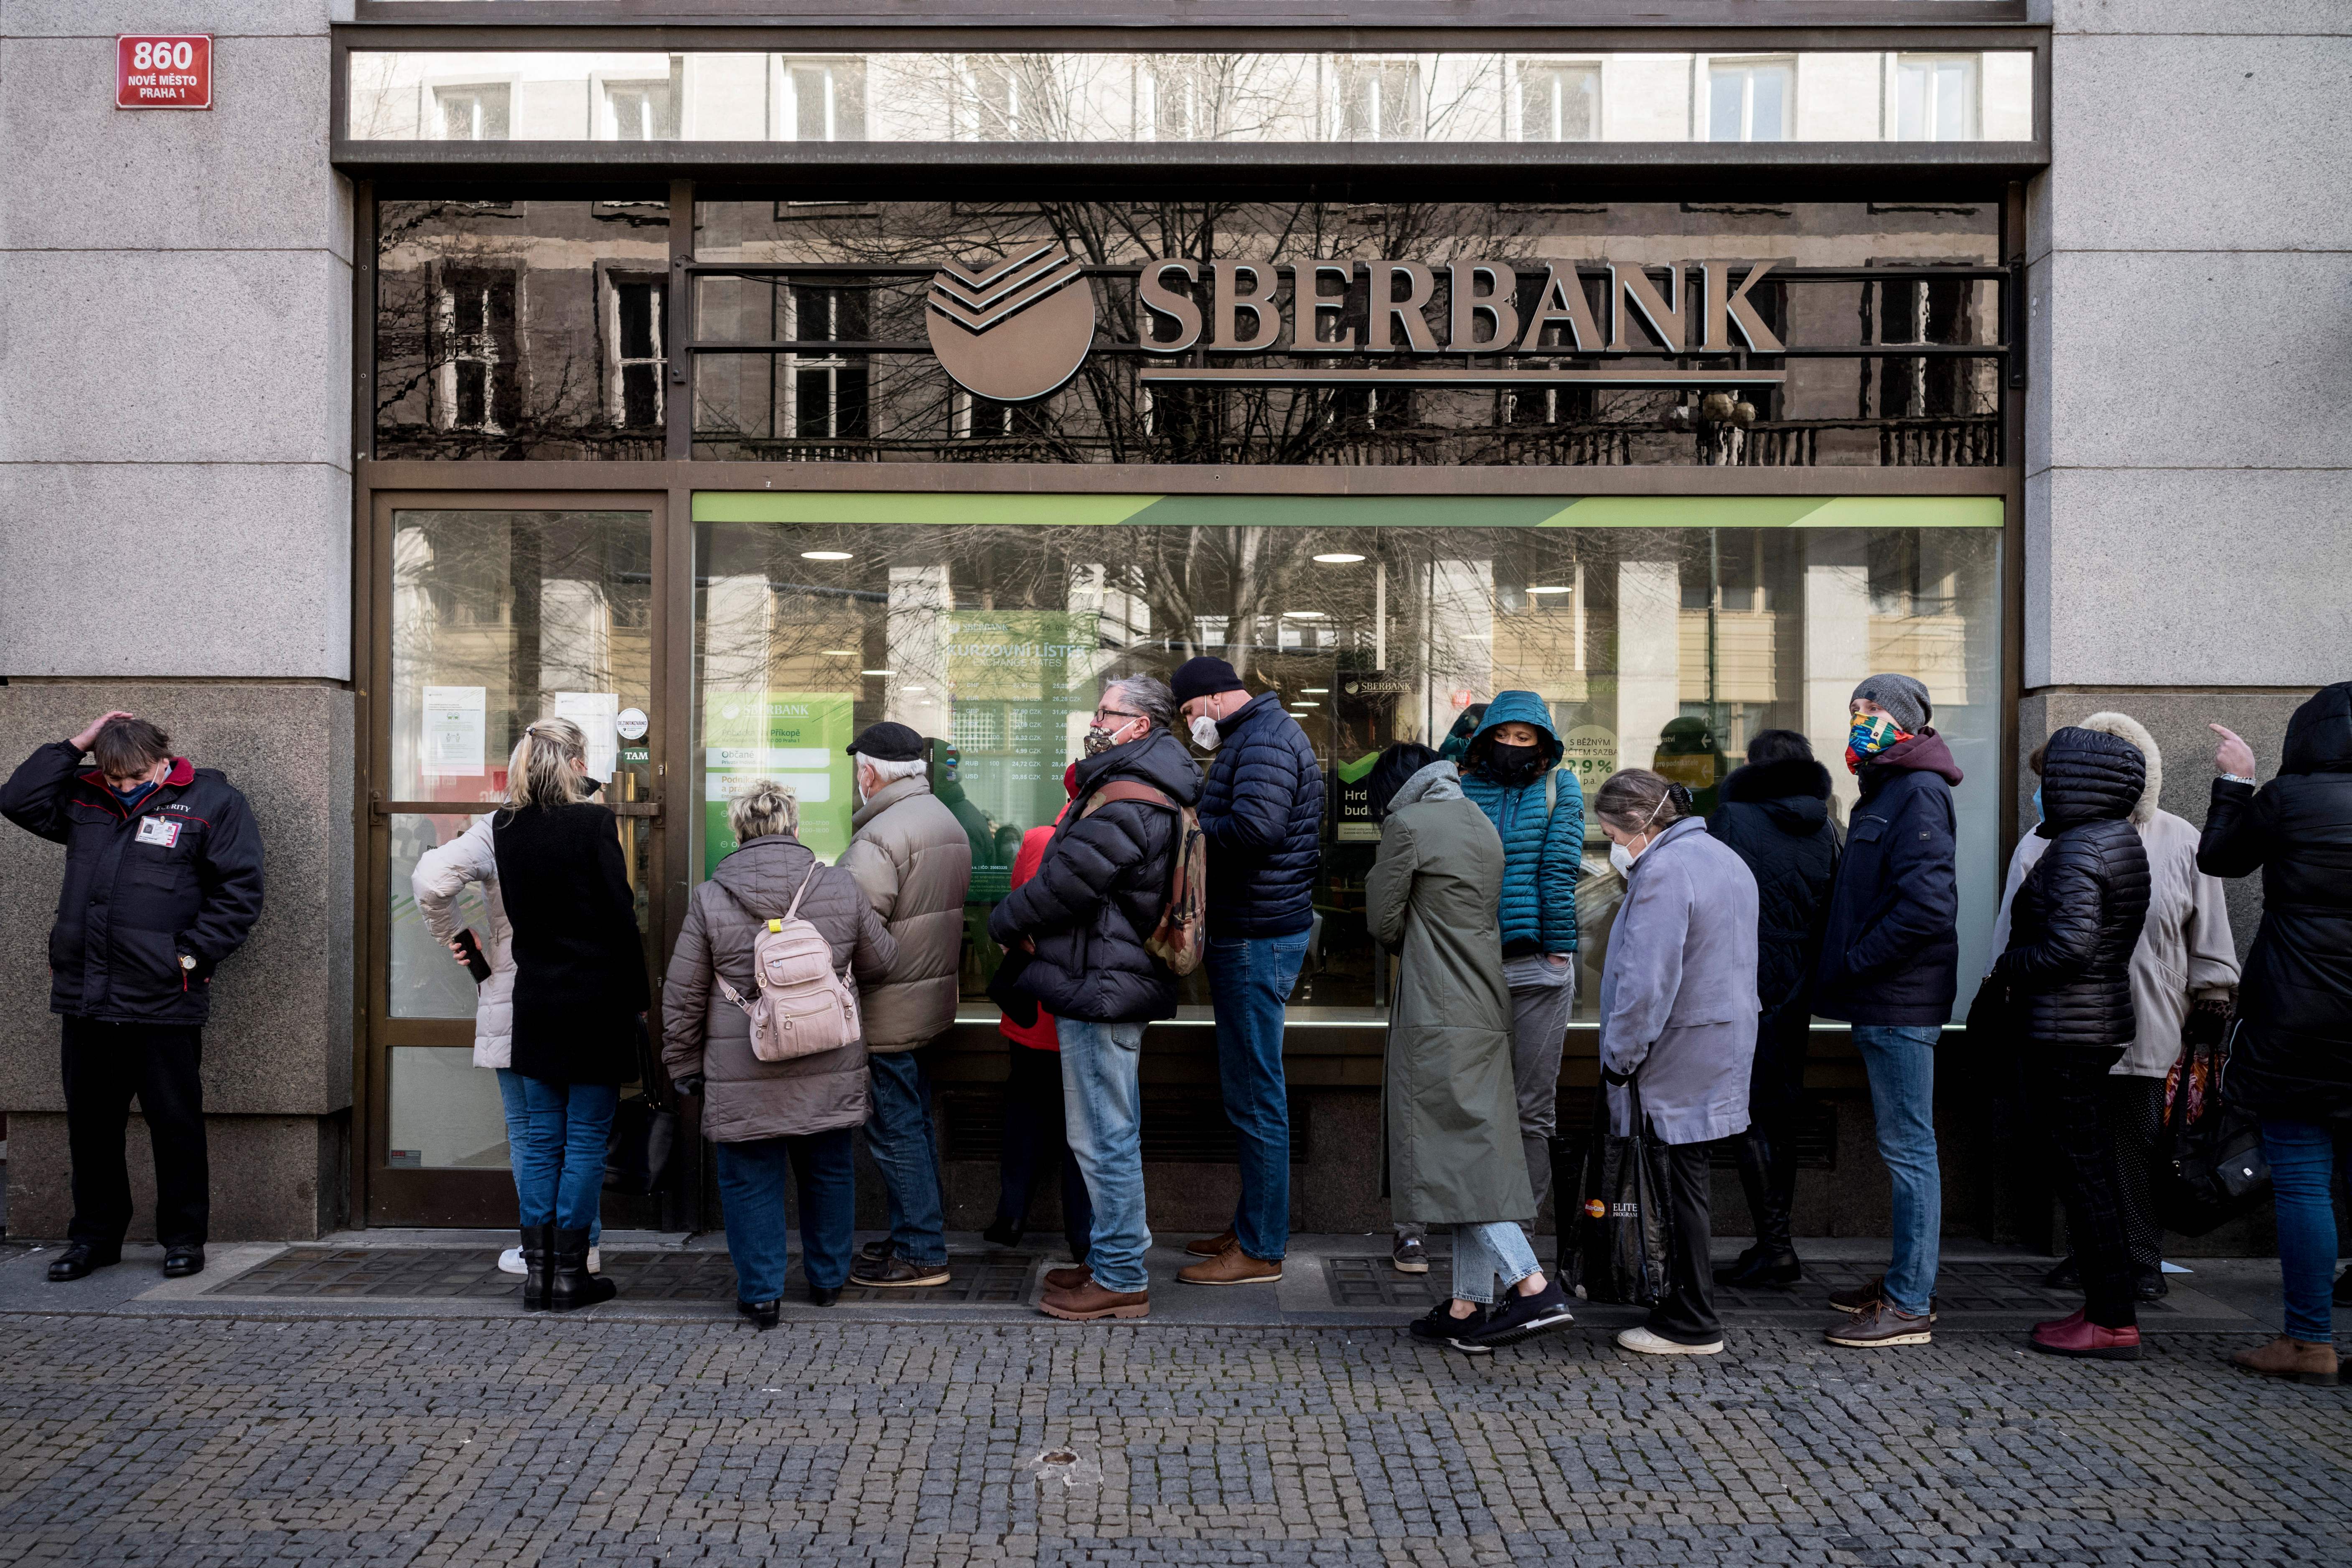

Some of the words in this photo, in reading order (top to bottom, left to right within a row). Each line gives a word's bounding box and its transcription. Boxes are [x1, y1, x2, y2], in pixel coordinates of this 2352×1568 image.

[134, 41, 193, 69] 860
[128, 73, 156, 86] NOVÉ
[159, 73, 197, 86] MĚSTO
[140, 88, 177, 98] PRAHA
[180, 88, 185, 98] 1
[1138, 258, 1789, 353] SBERBANK
[963, 623, 1009, 631] SBERBANK
[947, 642, 1030, 657] KURZOVNÍ
[1036, 642, 1088, 658] LÍSTEK
[973, 658, 1027, 667] EXCHANGE
[1030, 658, 1062, 667] RATES
[1361, 682, 1412, 691] SBERBANK
[770, 729, 800, 738] Příkopě
[1576, 737, 1610, 746] BĚŽNÝM
[625, 752, 649, 760] TAM
[1563, 747, 1590, 756] ÚČTEM
[1597, 760, 1613, 773] %
[1345, 790, 1367, 800] Hrd
[1345, 805, 1368, 816] bud
[1613, 1203, 1638, 1212] ELITE
